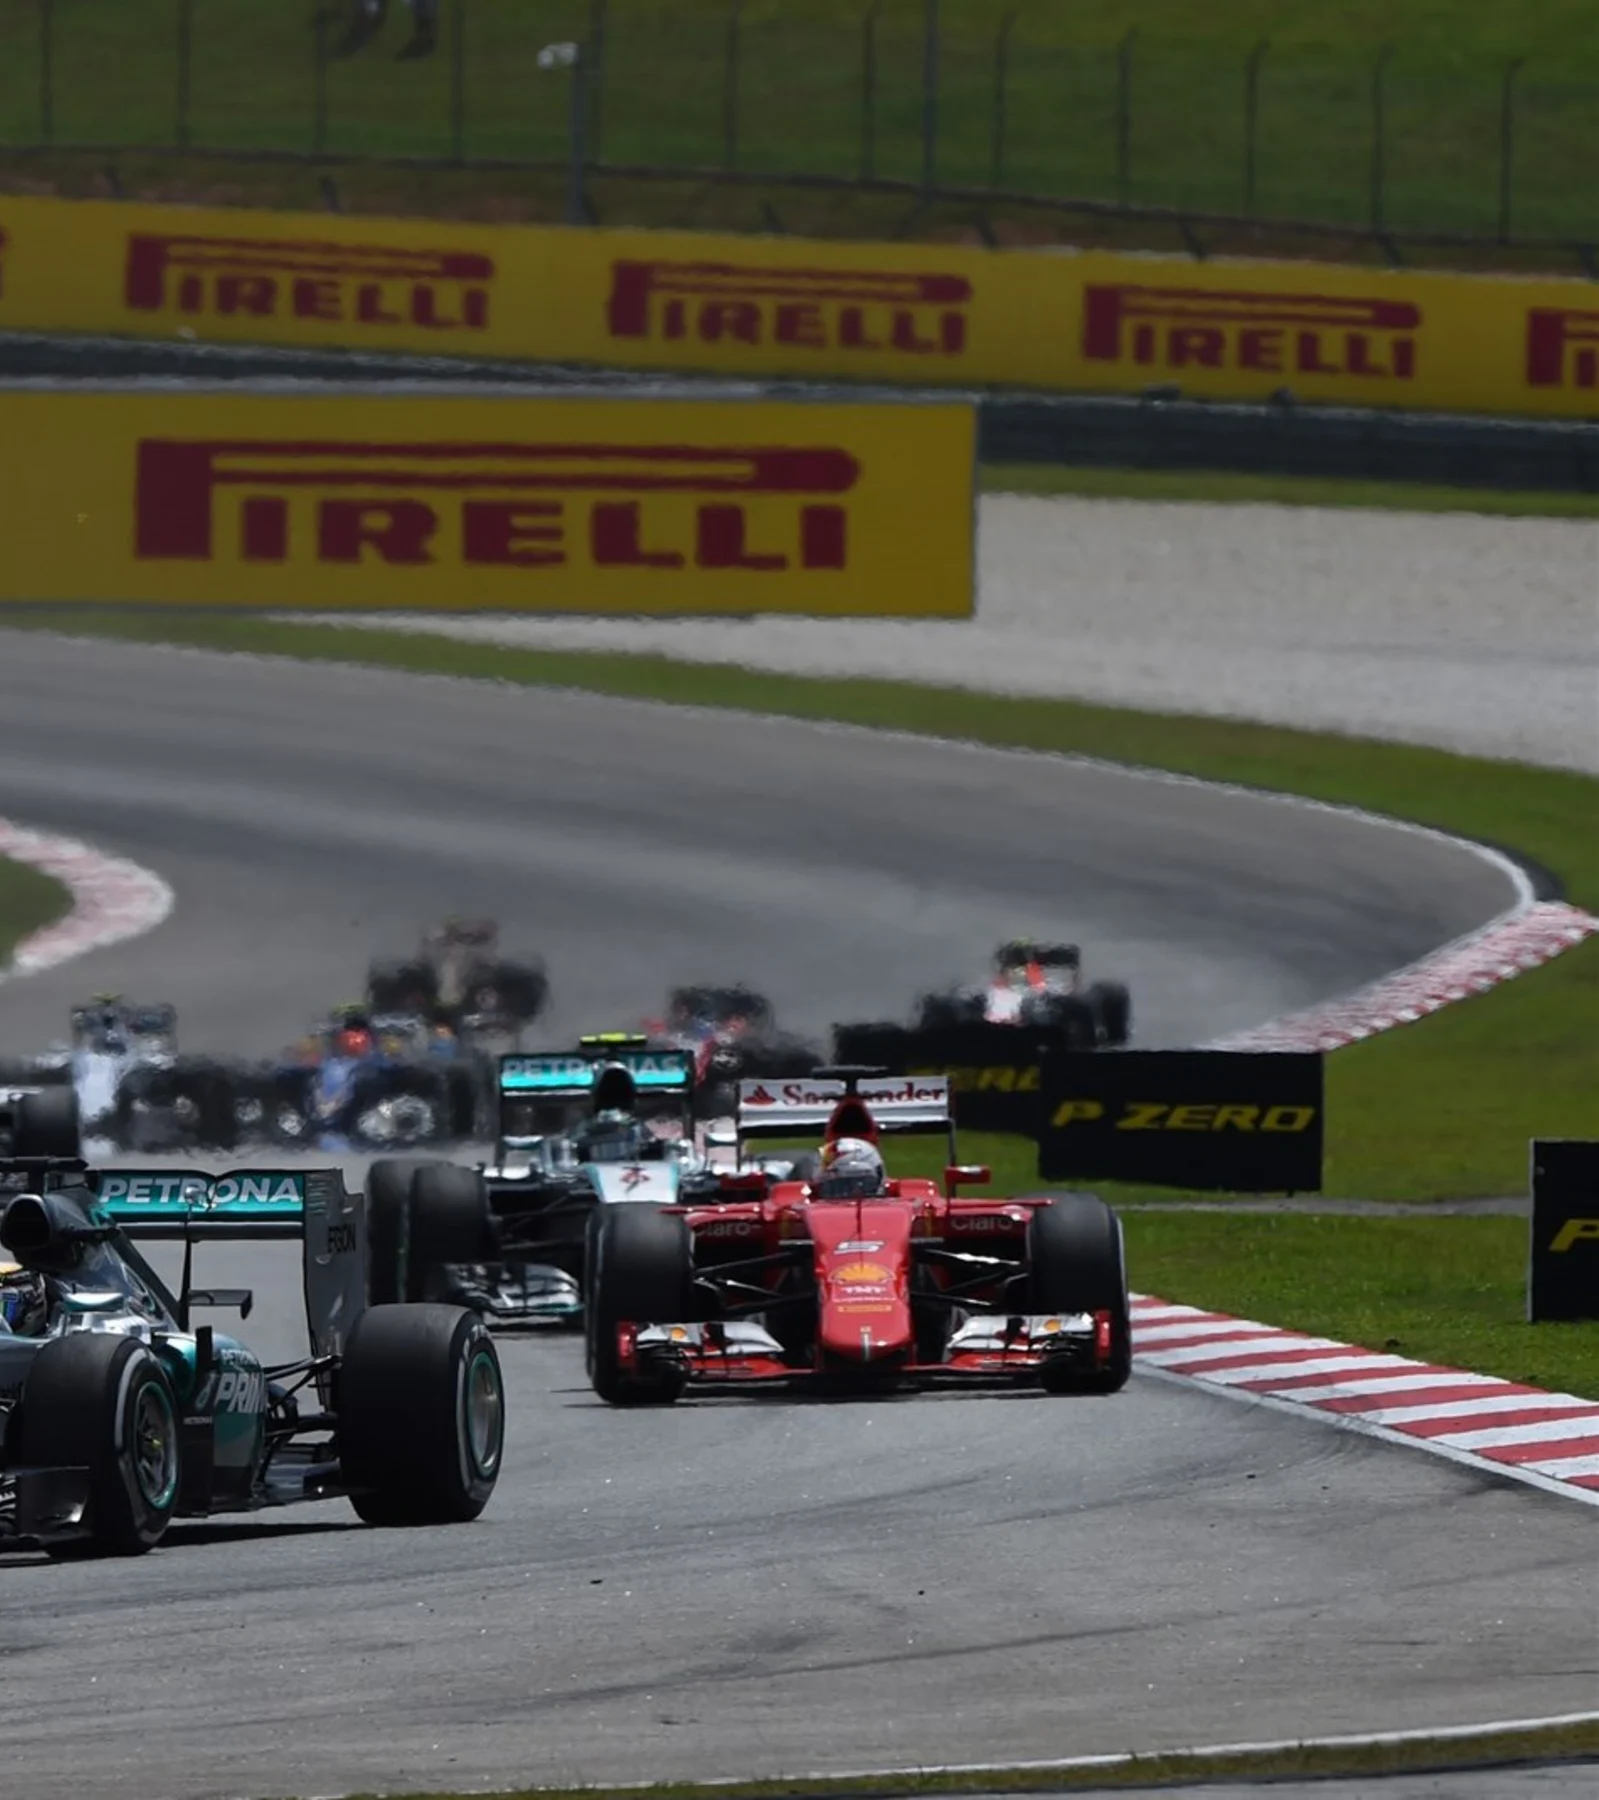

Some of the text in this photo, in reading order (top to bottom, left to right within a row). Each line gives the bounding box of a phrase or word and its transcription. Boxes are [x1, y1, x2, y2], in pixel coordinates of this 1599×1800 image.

[125, 234, 493, 328] PIRELLI
[608, 260, 971, 354] PIRELLI
[1083, 284, 1421, 379] PIRELLI
[134, 439, 860, 571] PIRELLI
[782, 1082, 946, 1106] Sanander
[1051, 1101, 1315, 1132] P ZERO
[99, 1177, 304, 1204] PETRONA
